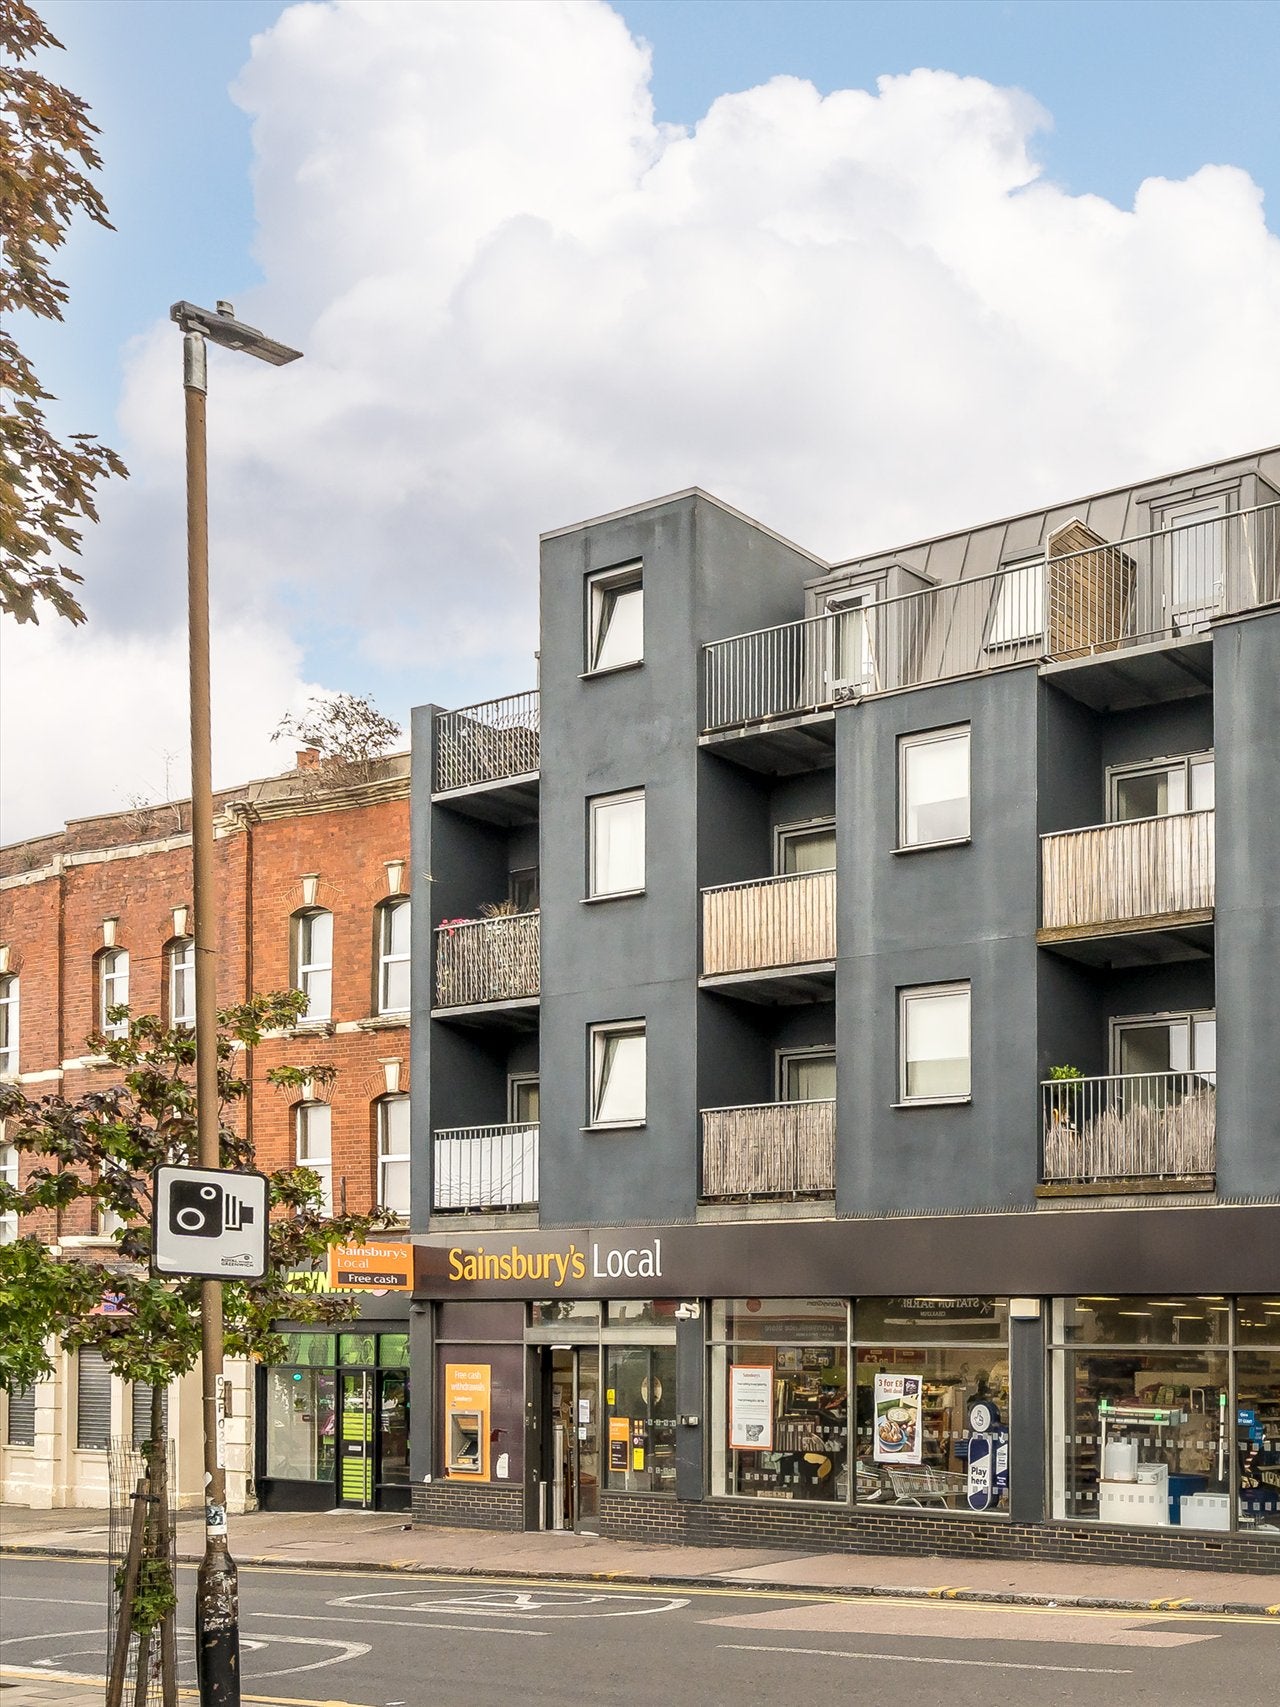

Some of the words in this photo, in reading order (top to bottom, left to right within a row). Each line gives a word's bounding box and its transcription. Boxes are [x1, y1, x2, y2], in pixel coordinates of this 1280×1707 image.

[337, 1245, 408, 1259] Sainsbury's
[337, 1259, 368, 1268] Local
[448, 1244, 586, 1287] Sainsbury's
[593, 1239, 662, 1278] Local
[348, 1274, 371, 1283] Free
[374, 1275, 398, 1284] cash
[467, 1371, 482, 1380] cash
[879, 1379, 883, 1387] 3
[884, 1379, 894, 1387] for
[895, 1380, 903, 1388] £8
[971, 1466, 987, 1477] Play
[971, 1476, 987, 1485] here
